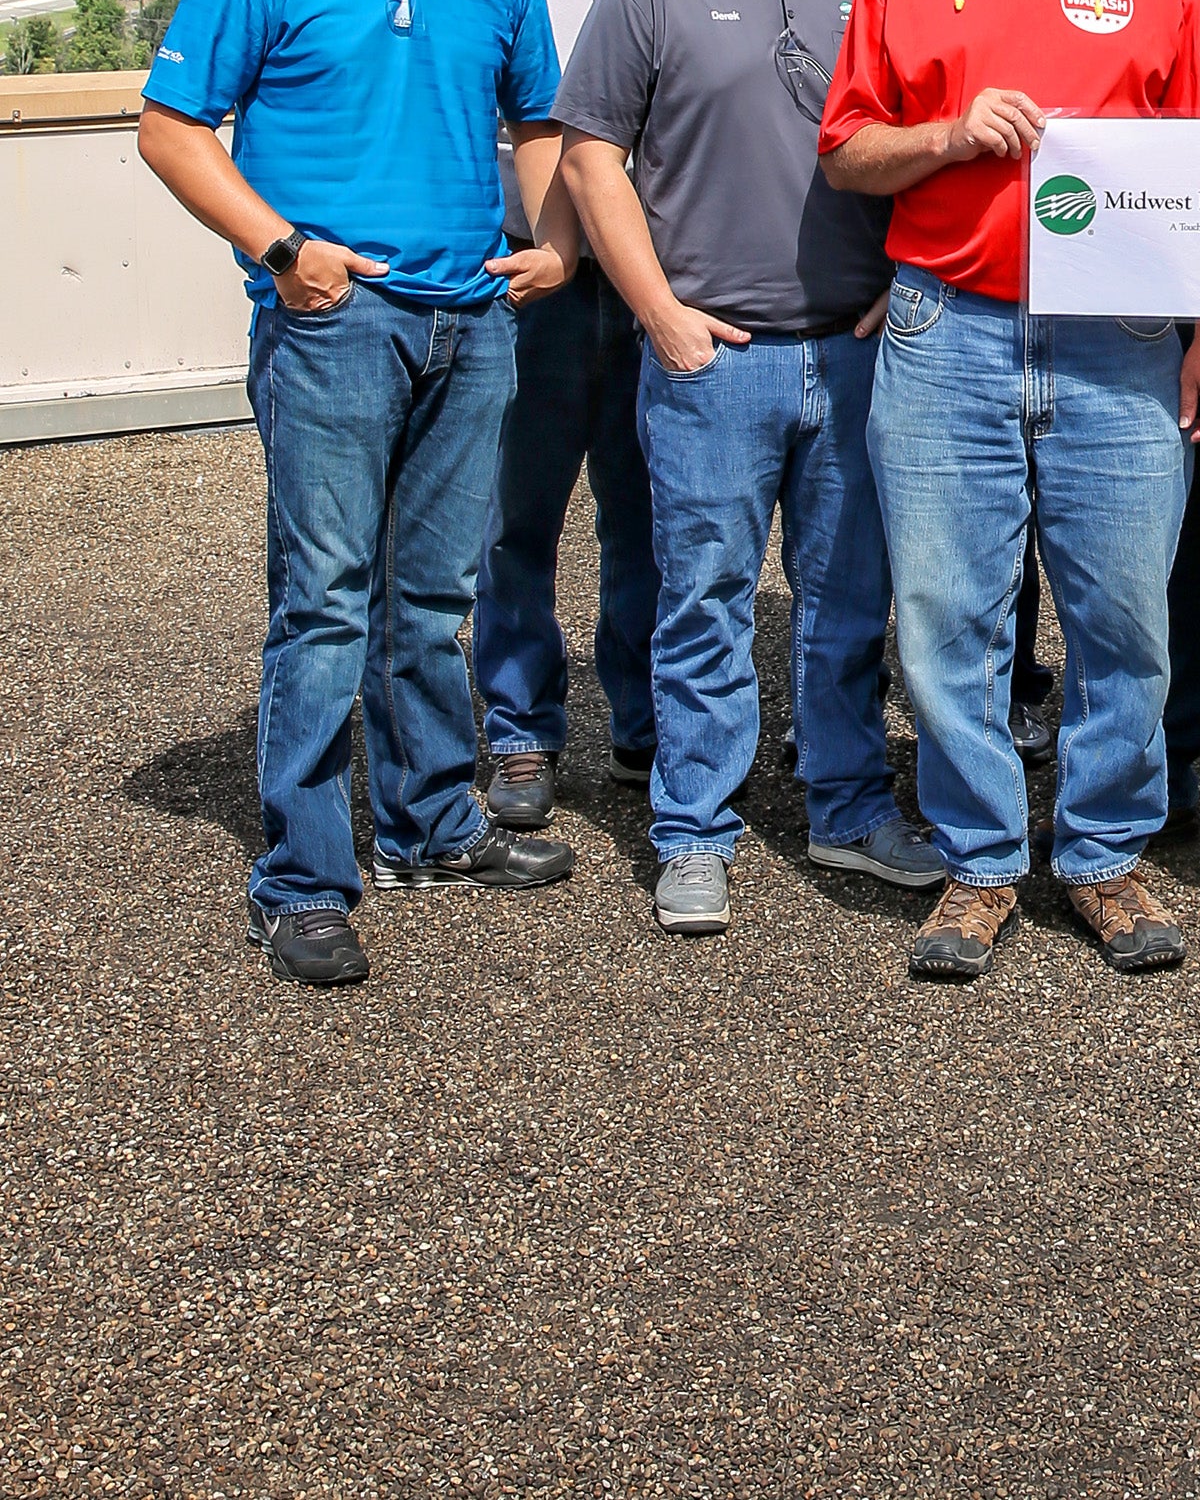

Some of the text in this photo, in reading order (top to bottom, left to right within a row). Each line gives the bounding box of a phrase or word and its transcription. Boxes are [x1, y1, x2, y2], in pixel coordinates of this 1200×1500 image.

[710, 10, 740, 21] Derek
[1104, 190, 1192, 210] Midwest
[1169, 223, 1177, 231] A
